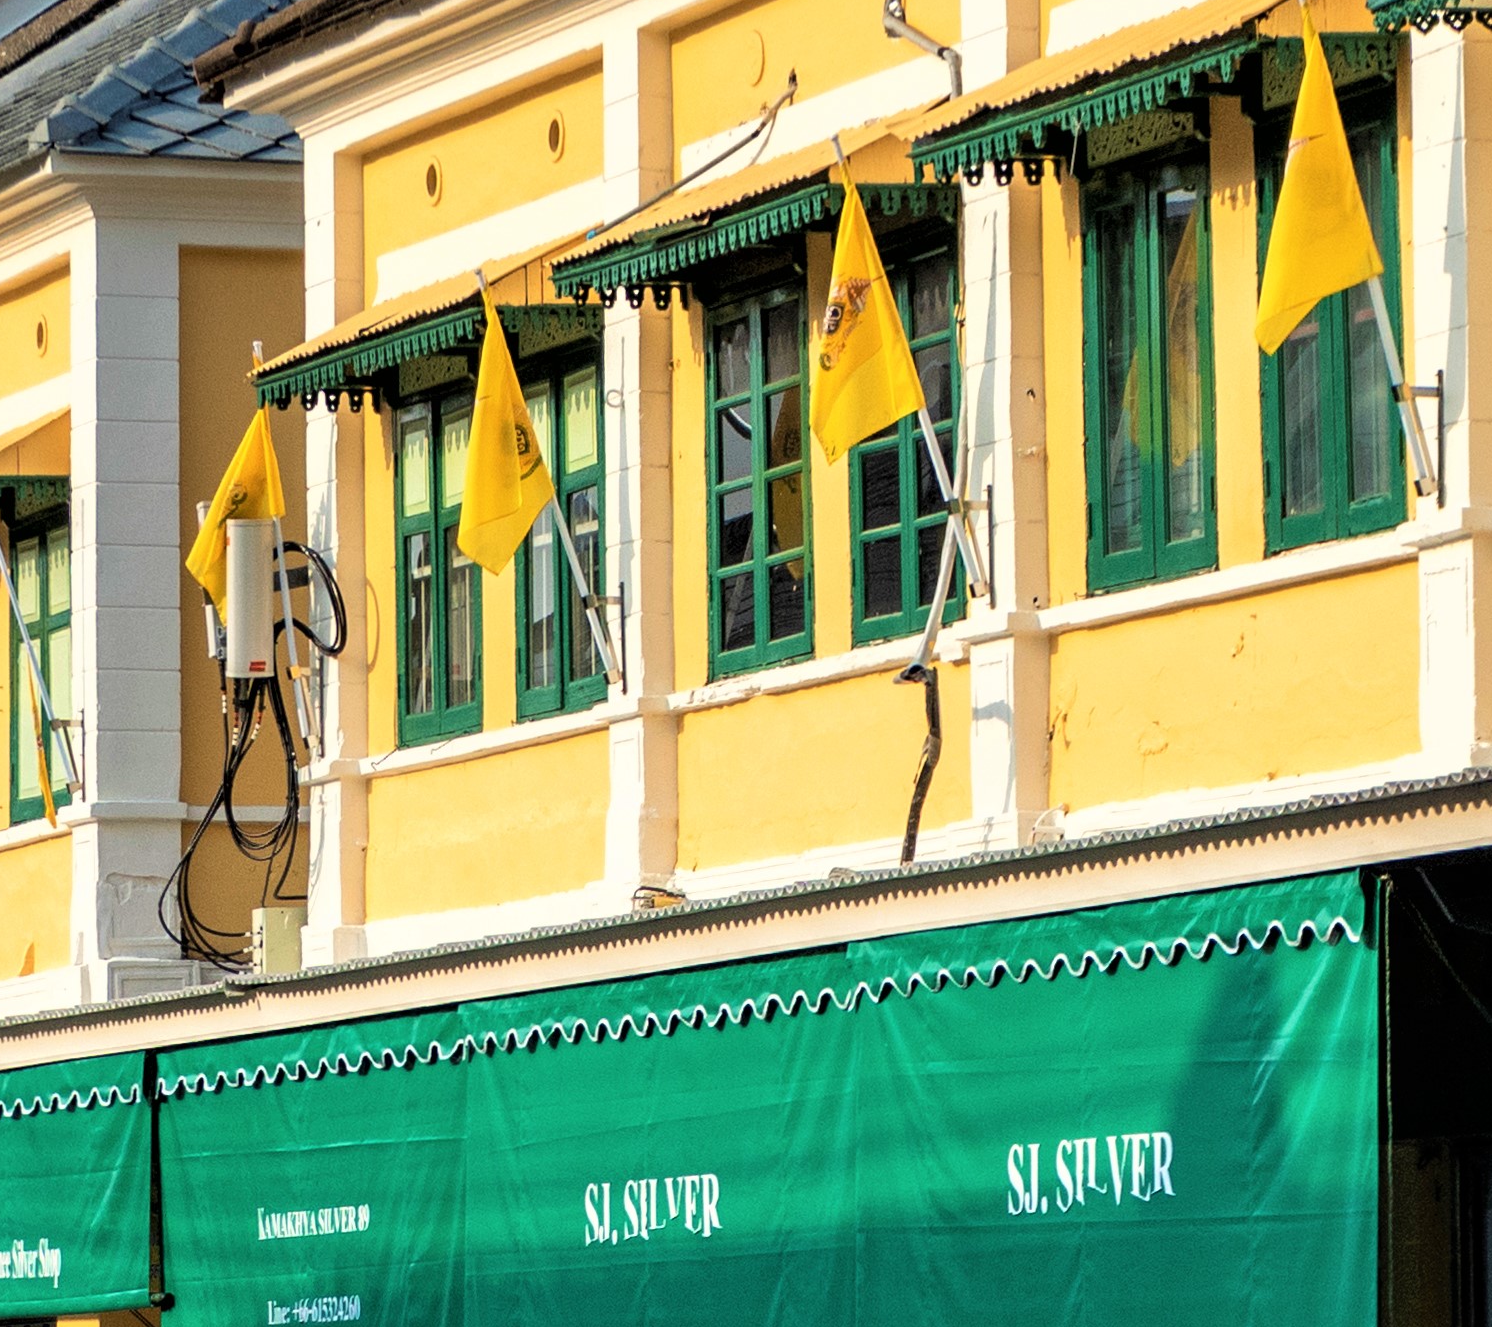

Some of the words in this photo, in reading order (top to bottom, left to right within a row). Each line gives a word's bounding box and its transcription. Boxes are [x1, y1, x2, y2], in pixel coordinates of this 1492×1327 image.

[1055, 1131, 1176, 1212] SILVER
[318, 1204, 357, 1236] SILVER
[623, 1172, 723, 1242] SILVER
[11, 1238, 38, 1279] Silver
[38, 1237, 62, 1289] Shop
[267, 1299, 291, 1325] Line:
